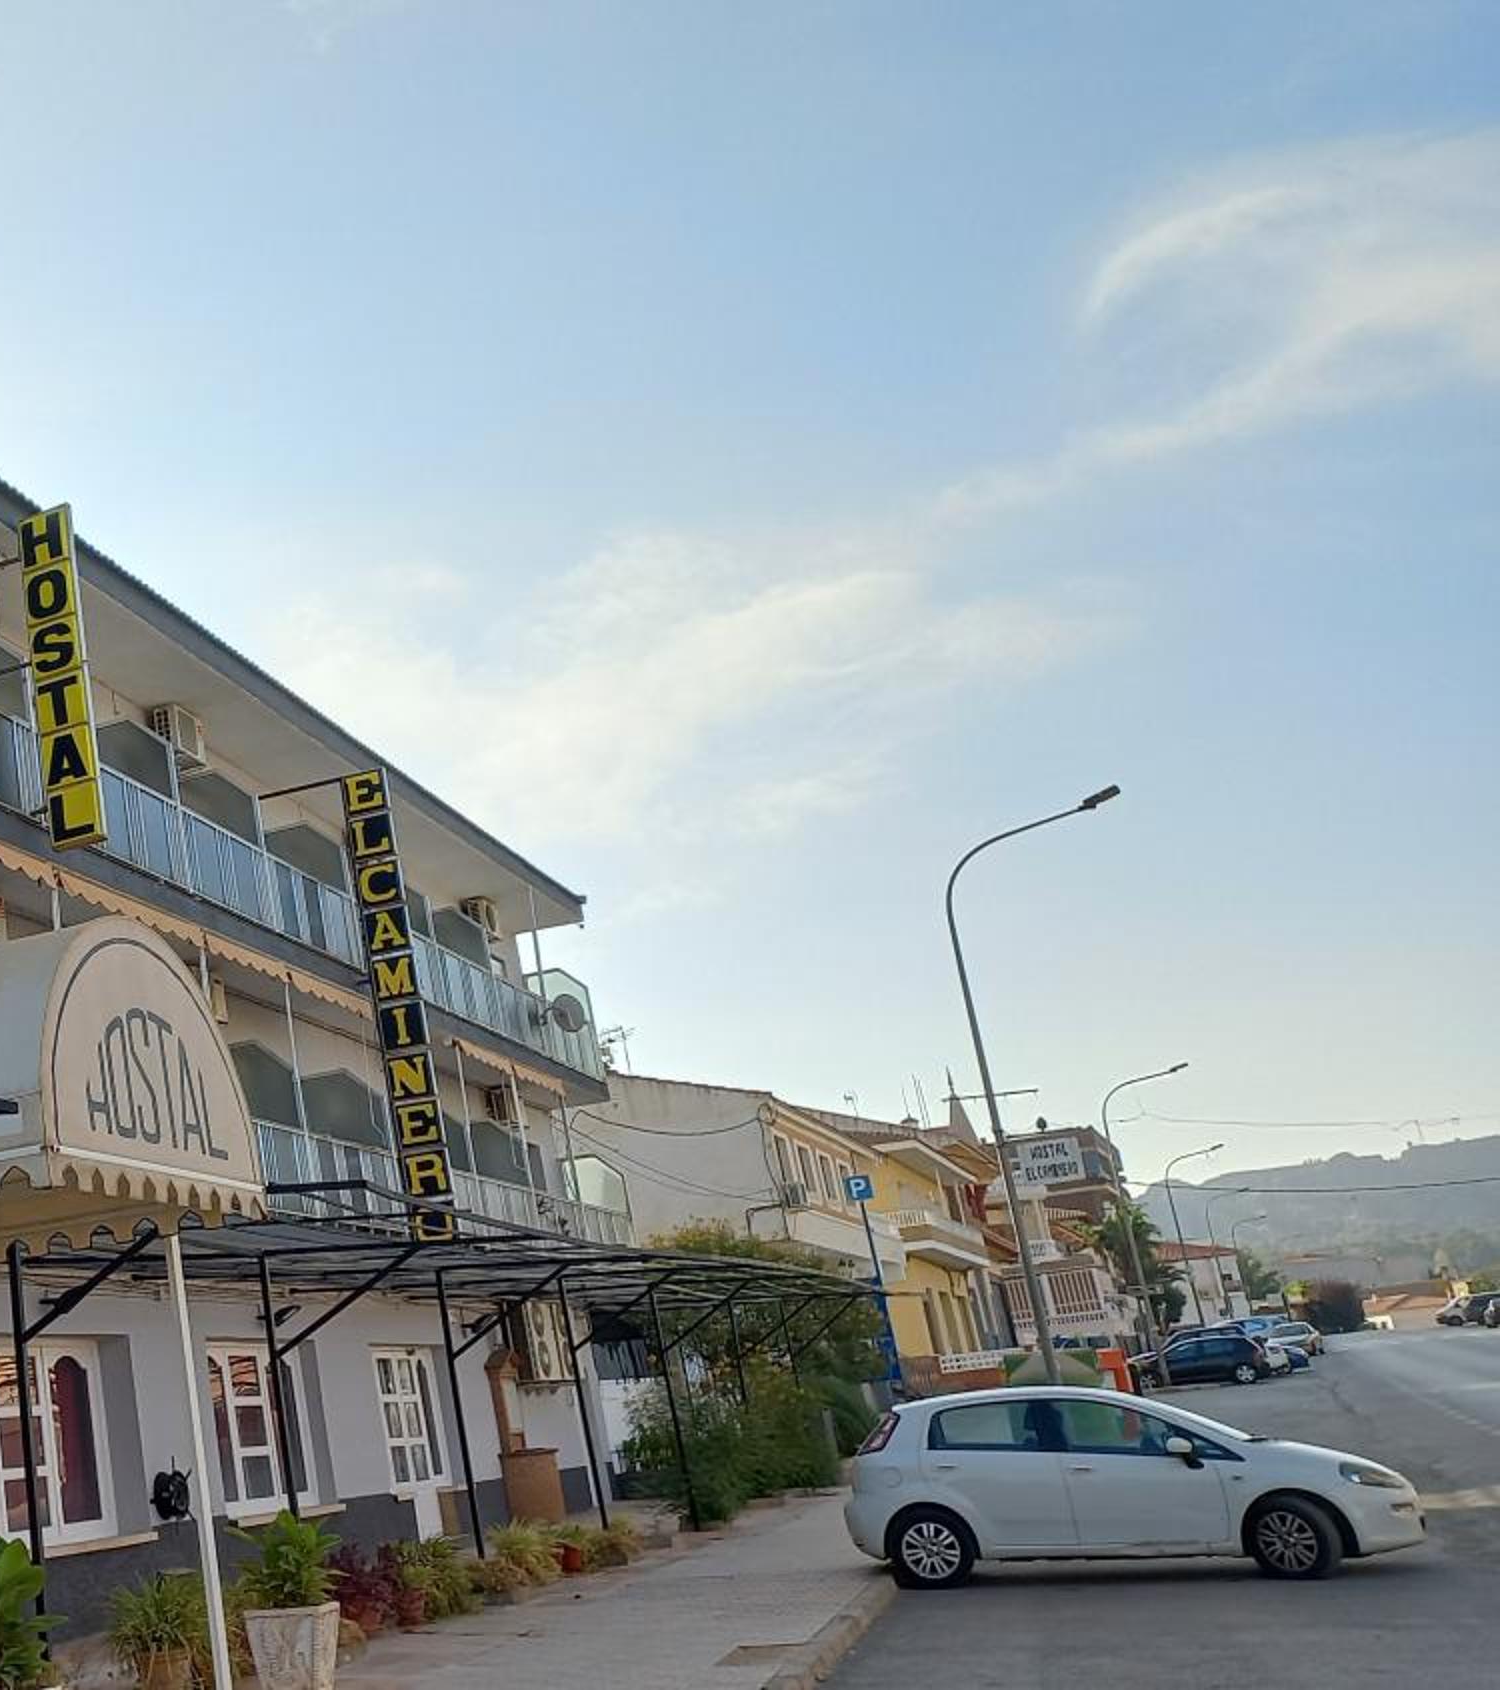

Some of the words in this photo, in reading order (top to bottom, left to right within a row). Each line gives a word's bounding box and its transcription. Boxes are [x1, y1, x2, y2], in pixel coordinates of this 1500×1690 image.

[21, 511, 95, 843] HOSTAL
[86, 1007, 229, 1161] HOSTAL
[849, 1178, 866, 1199] P
[1029, 1142, 1069, 1160] HOSTAL
